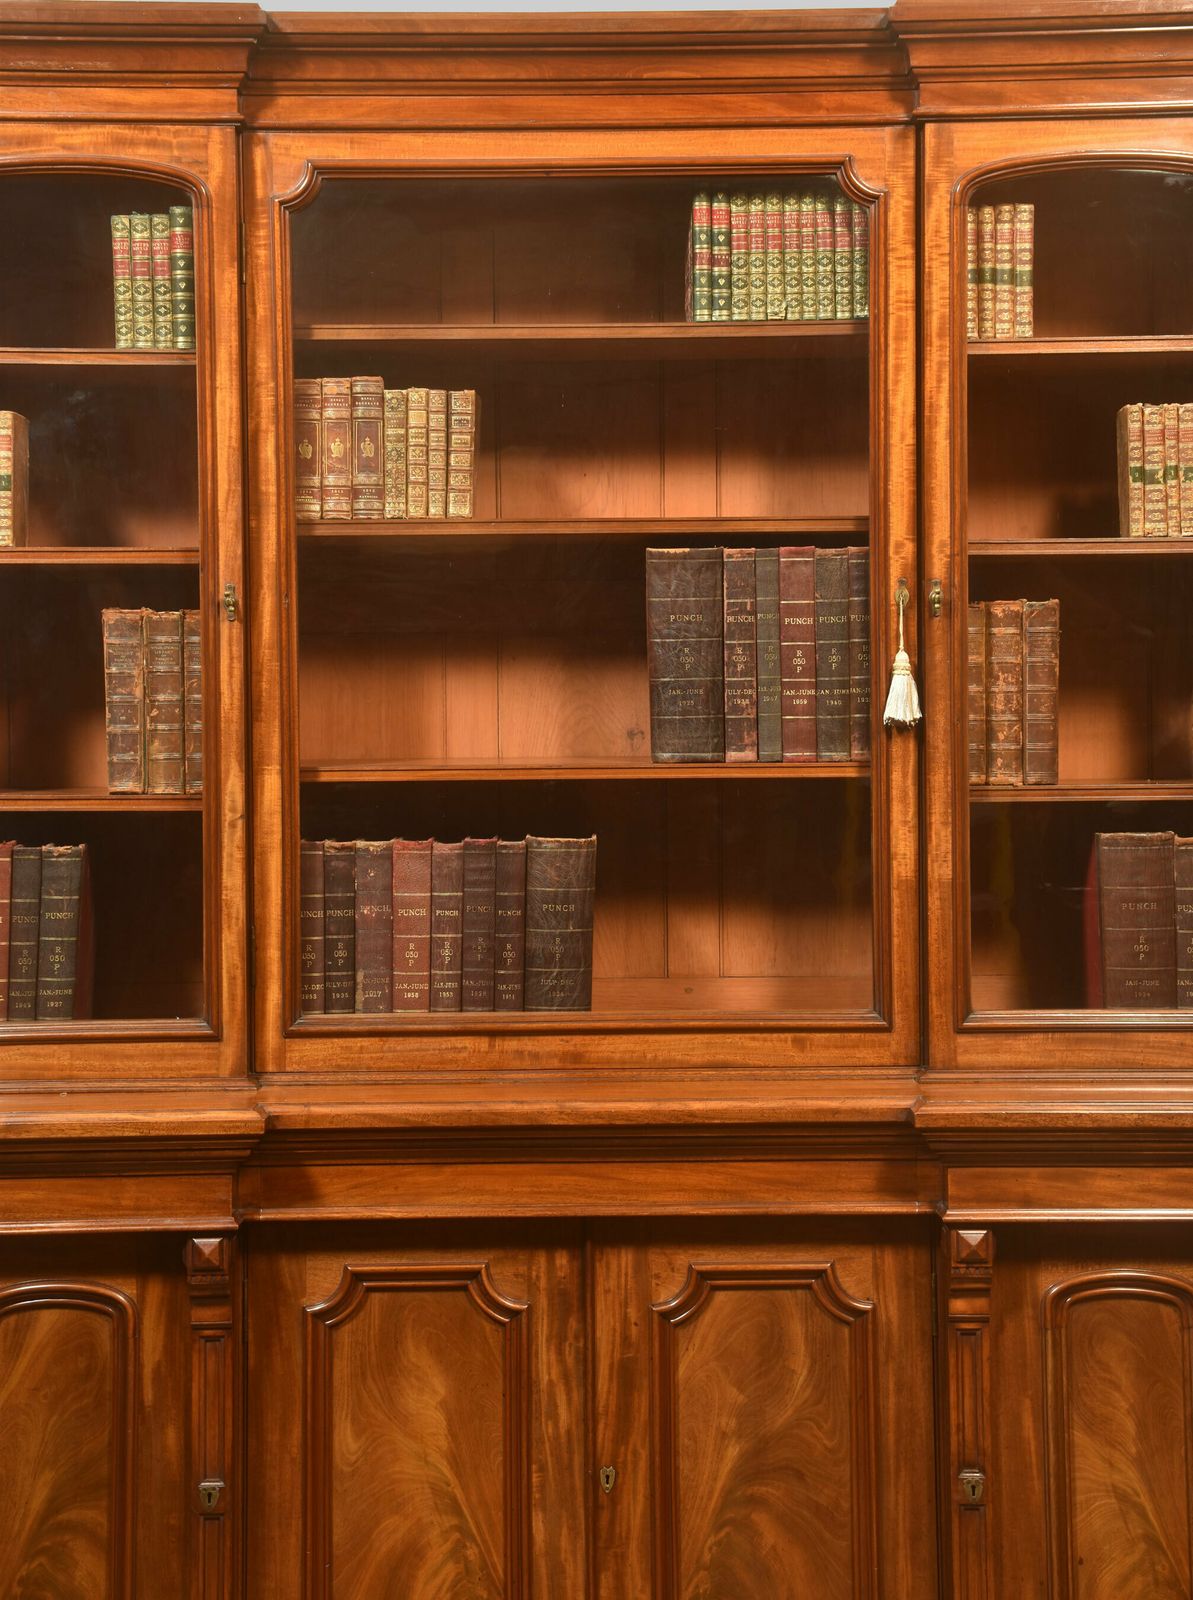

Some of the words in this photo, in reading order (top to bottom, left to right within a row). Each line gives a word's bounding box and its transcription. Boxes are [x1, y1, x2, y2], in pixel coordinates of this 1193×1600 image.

[670, 614, 703, 622] PUNCH
[726, 615, 755, 623] PUNCH
[783, 617, 814, 625] PUNCH
[819, 615, 847, 623] PUNCH
[466, 905, 494, 913] PUNCH
[542, 904, 575, 912] PUNCH
[1121, 902, 1157, 910] PUNCH
[45, 912, 74, 920] PUNCH
[300, 910, 324, 918] UNCH
[326, 909, 354, 917] PUNCH
[398, 908, 427, 916] PUNCH
[435, 909, 459, 917] PUNCH
[49, 954, 66, 962] 050
[333, 950, 348, 958] 050
